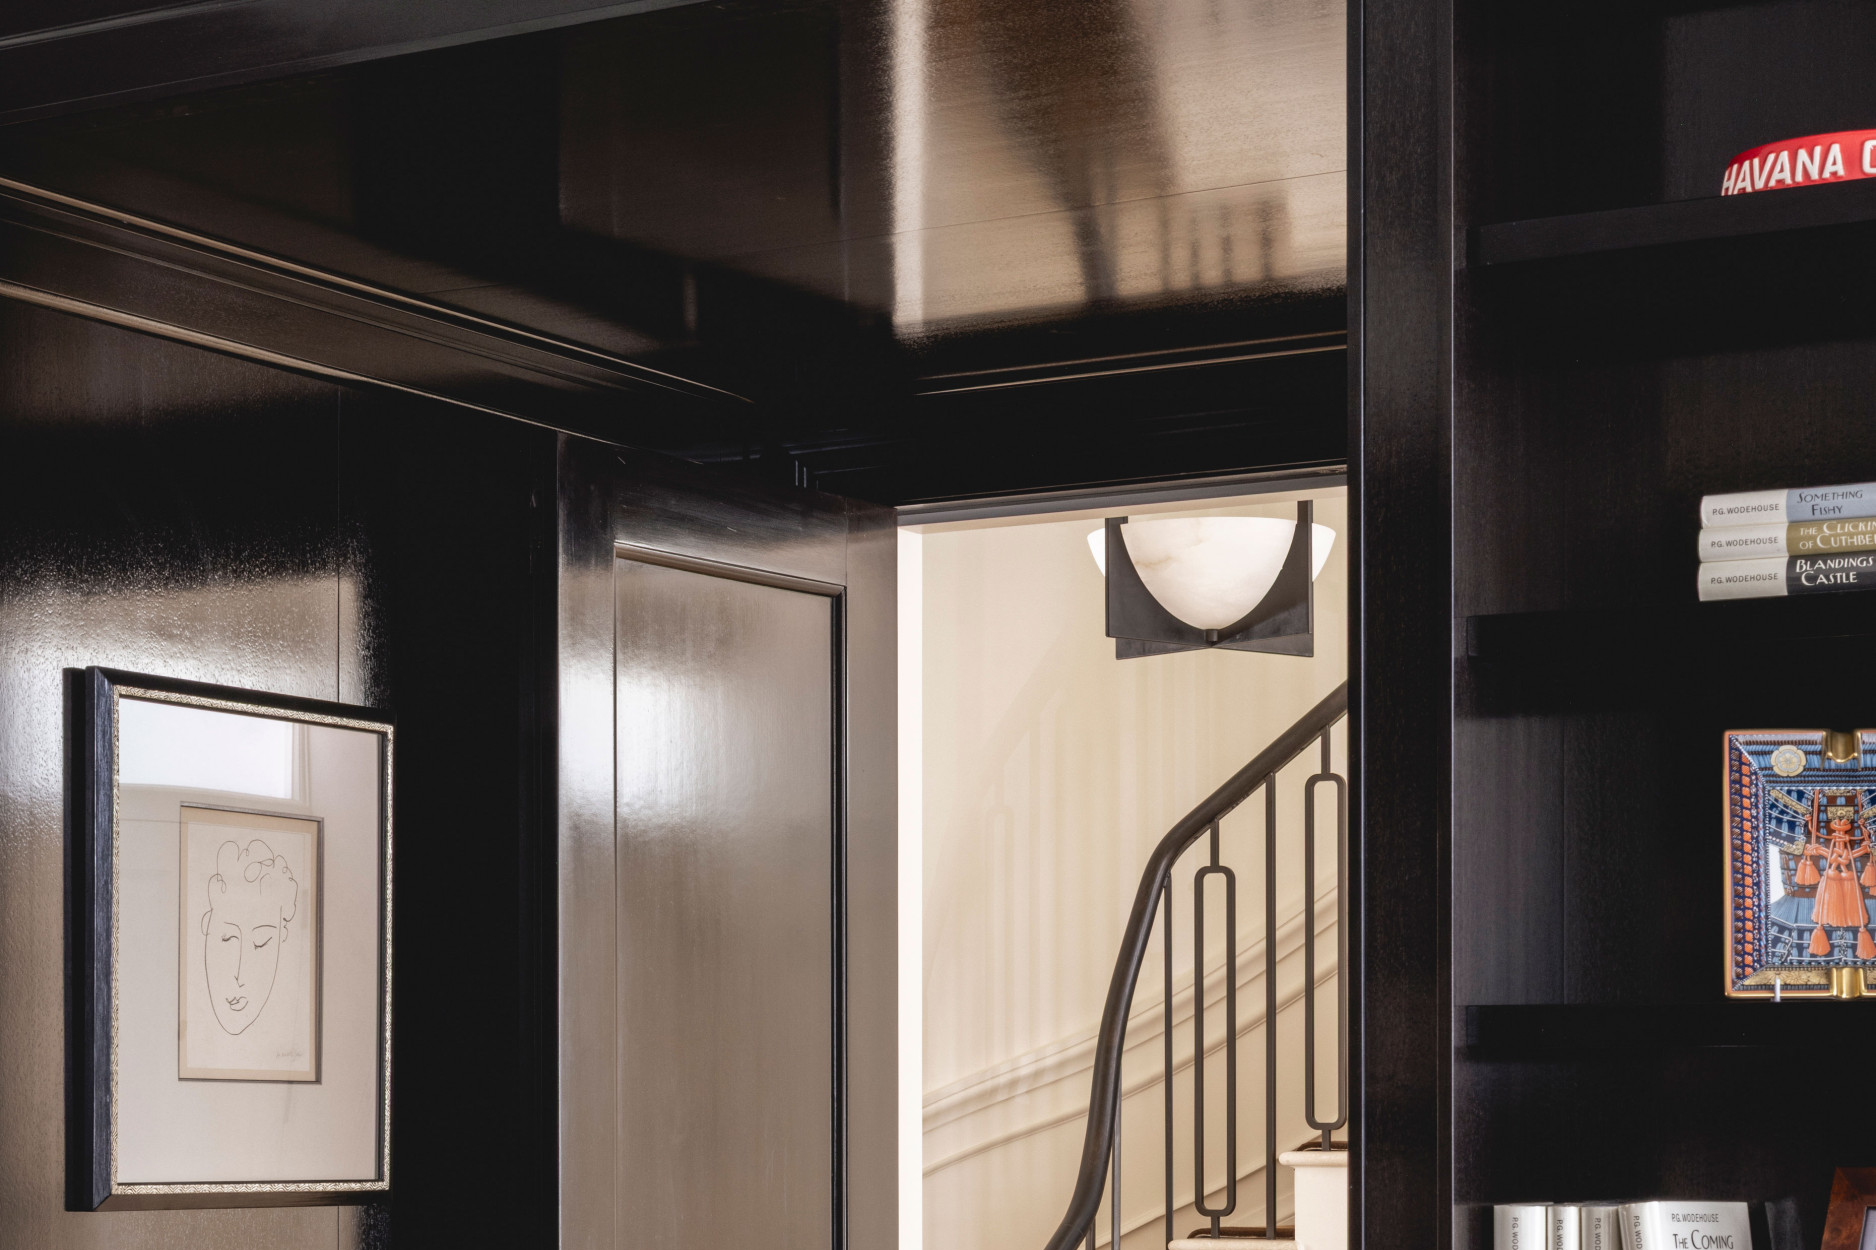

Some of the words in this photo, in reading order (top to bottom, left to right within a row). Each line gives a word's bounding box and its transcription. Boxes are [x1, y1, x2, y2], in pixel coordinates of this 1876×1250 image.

[1721, 143, 1845, 196] HAVANA
[1797, 490, 1863, 503] SOMETHING
[1727, 503, 1779, 514] WODEHOUSE
[1811, 504, 1843, 516] FISHY
[1800, 527, 1818, 536] THE
[1725, 536, 1778, 547] WODEHOUSE
[1799, 541, 1814, 549] OF
[1816, 533, 1876, 548] CUTHBE
[1796, 556, 1874, 573] BLANDINGS
[1725, 572, 1778, 583] WODEHOUSE
[1801, 571, 1857, 586] CASTLE
[1682, 1213, 1719, 1222] WODEHOUSE
[1673, 1233, 1689, 1249] THE
[1691, 1229, 1734, 1250] COMING
